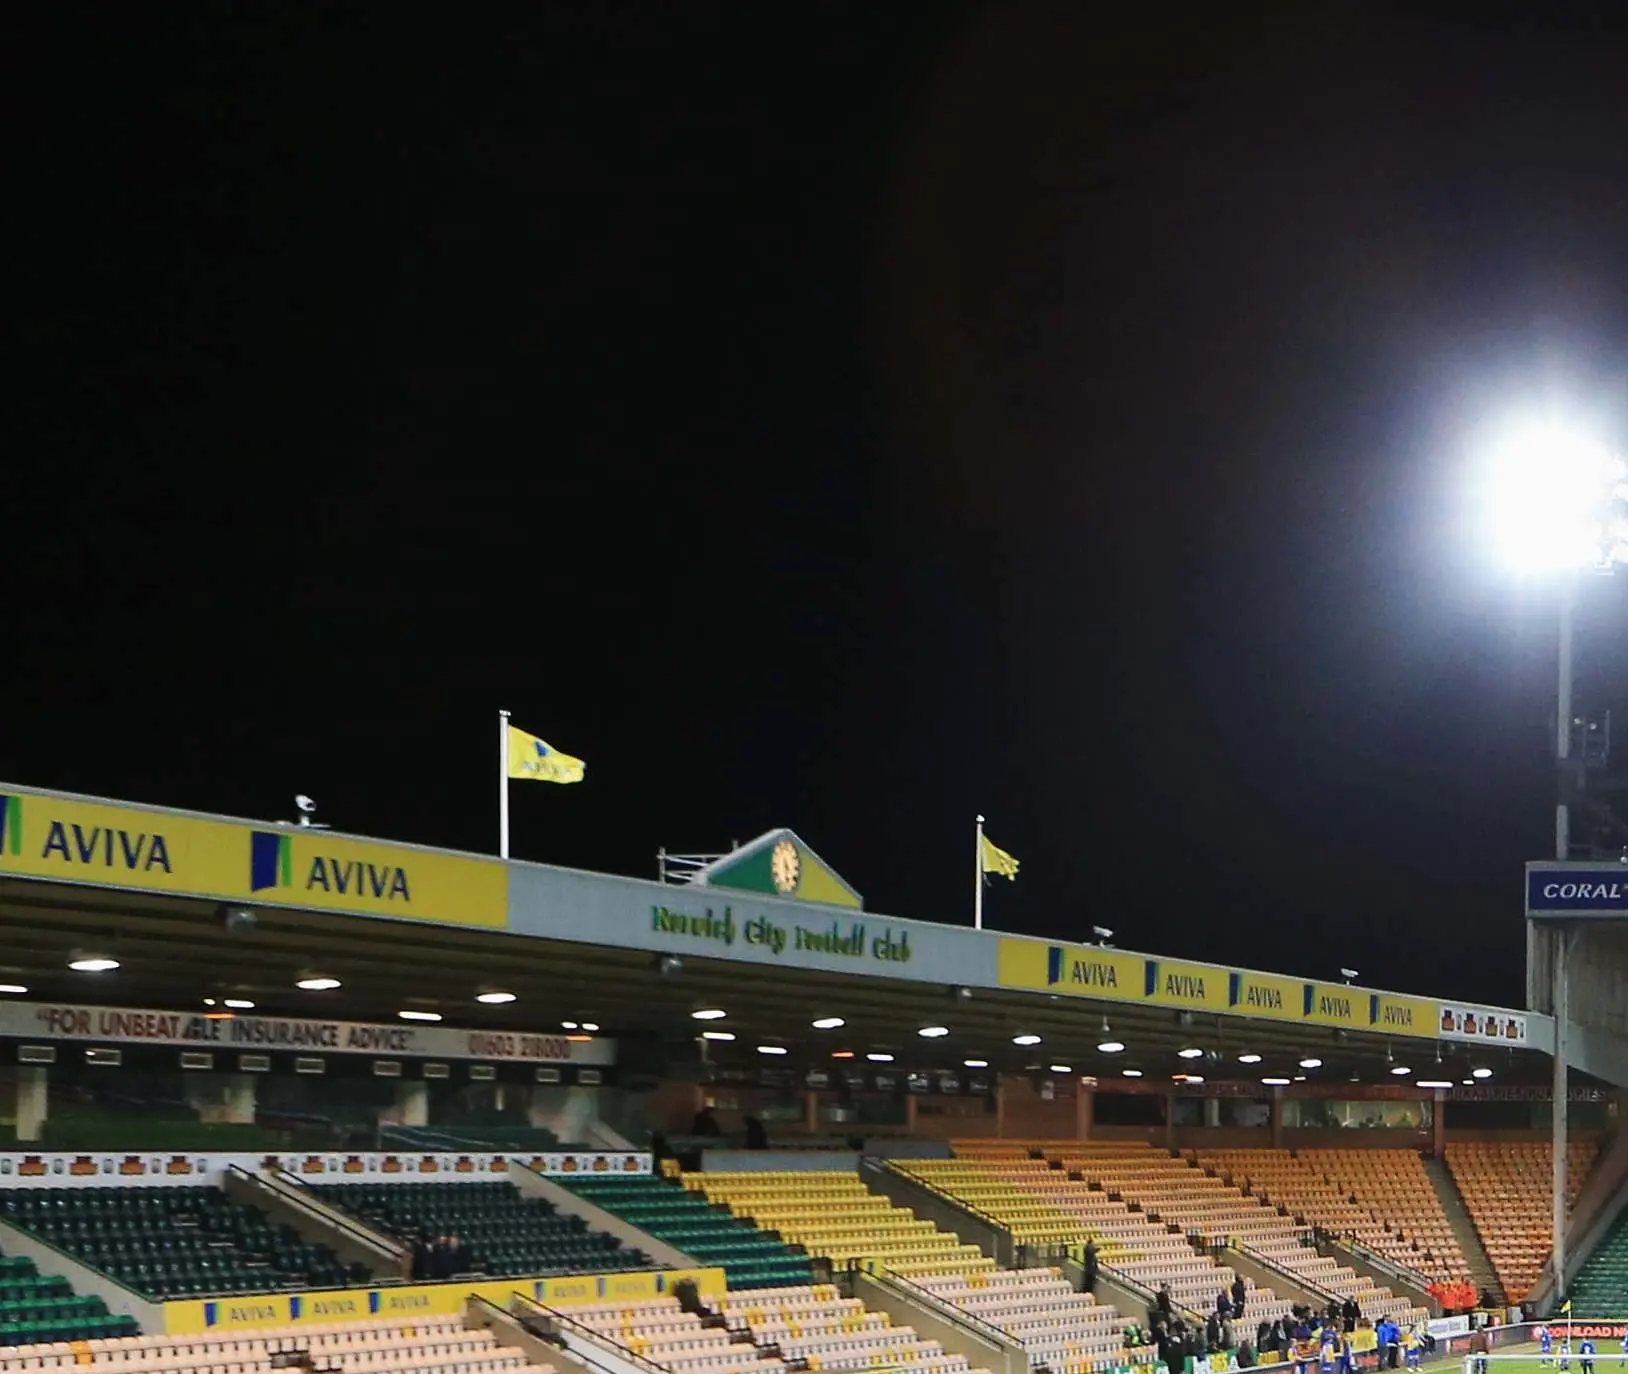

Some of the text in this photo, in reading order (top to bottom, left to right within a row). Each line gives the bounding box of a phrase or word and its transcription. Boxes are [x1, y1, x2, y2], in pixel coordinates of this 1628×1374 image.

[42, 820, 173, 874] AVIVA
[306, 856, 411, 901] AVIVA
[1543, 883, 1621, 899] CORAL
[744, 914, 786, 955] City
[873, 927, 912, 962] Club
[1072, 960, 1118, 988] AVIVA
[1166, 974, 1205, 999] AVIVA
[1247, 985, 1283, 1010] AVIVA
[1320, 996, 1351, 1018] AVIVA
[1384, 1006, 1413, 1027] AVIVA
[230, 1017, 338, 1048] INSURANCE
[231, 1305, 276, 1322] AVIVA
